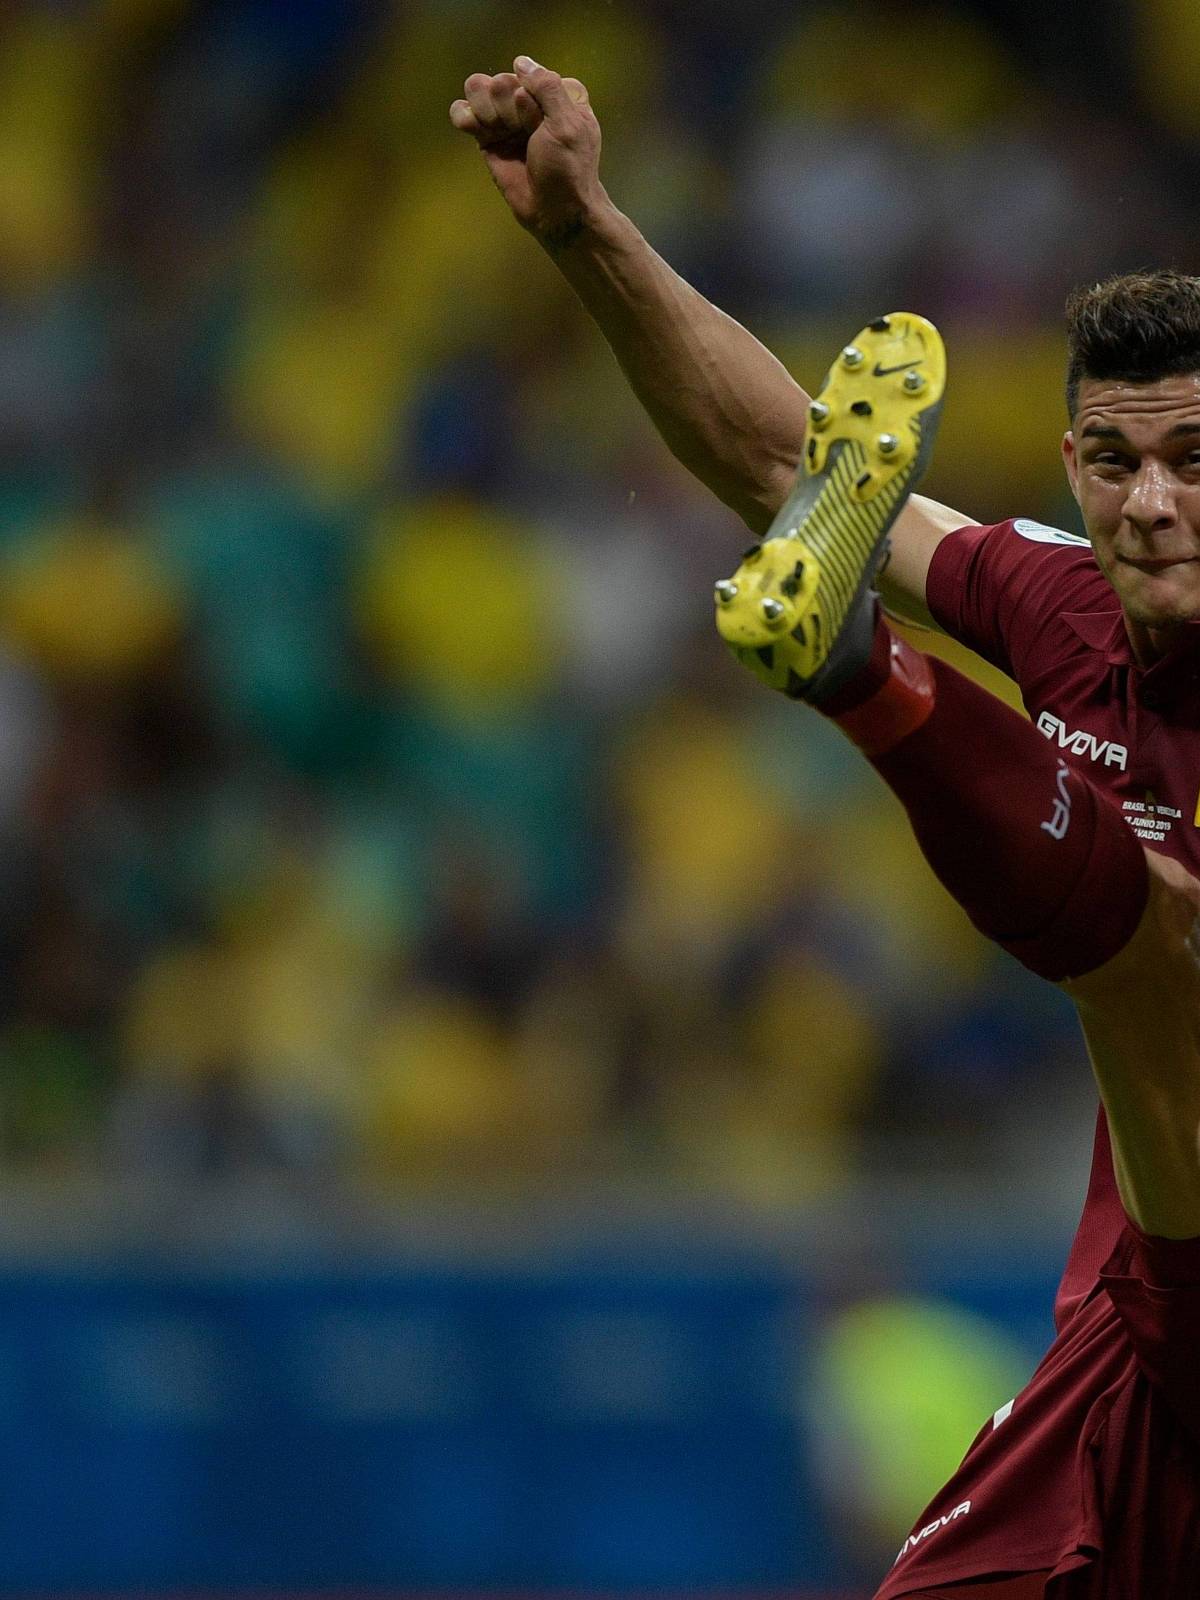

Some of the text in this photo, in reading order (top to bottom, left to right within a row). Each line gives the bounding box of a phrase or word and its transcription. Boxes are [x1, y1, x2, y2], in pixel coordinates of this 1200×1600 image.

[1122, 801, 1146, 812] BRASIL
[1131, 817, 1155, 828] JUNIO
[1155, 820, 1171, 830] 2019
[1134, 828, 1165, 841] VADOR
